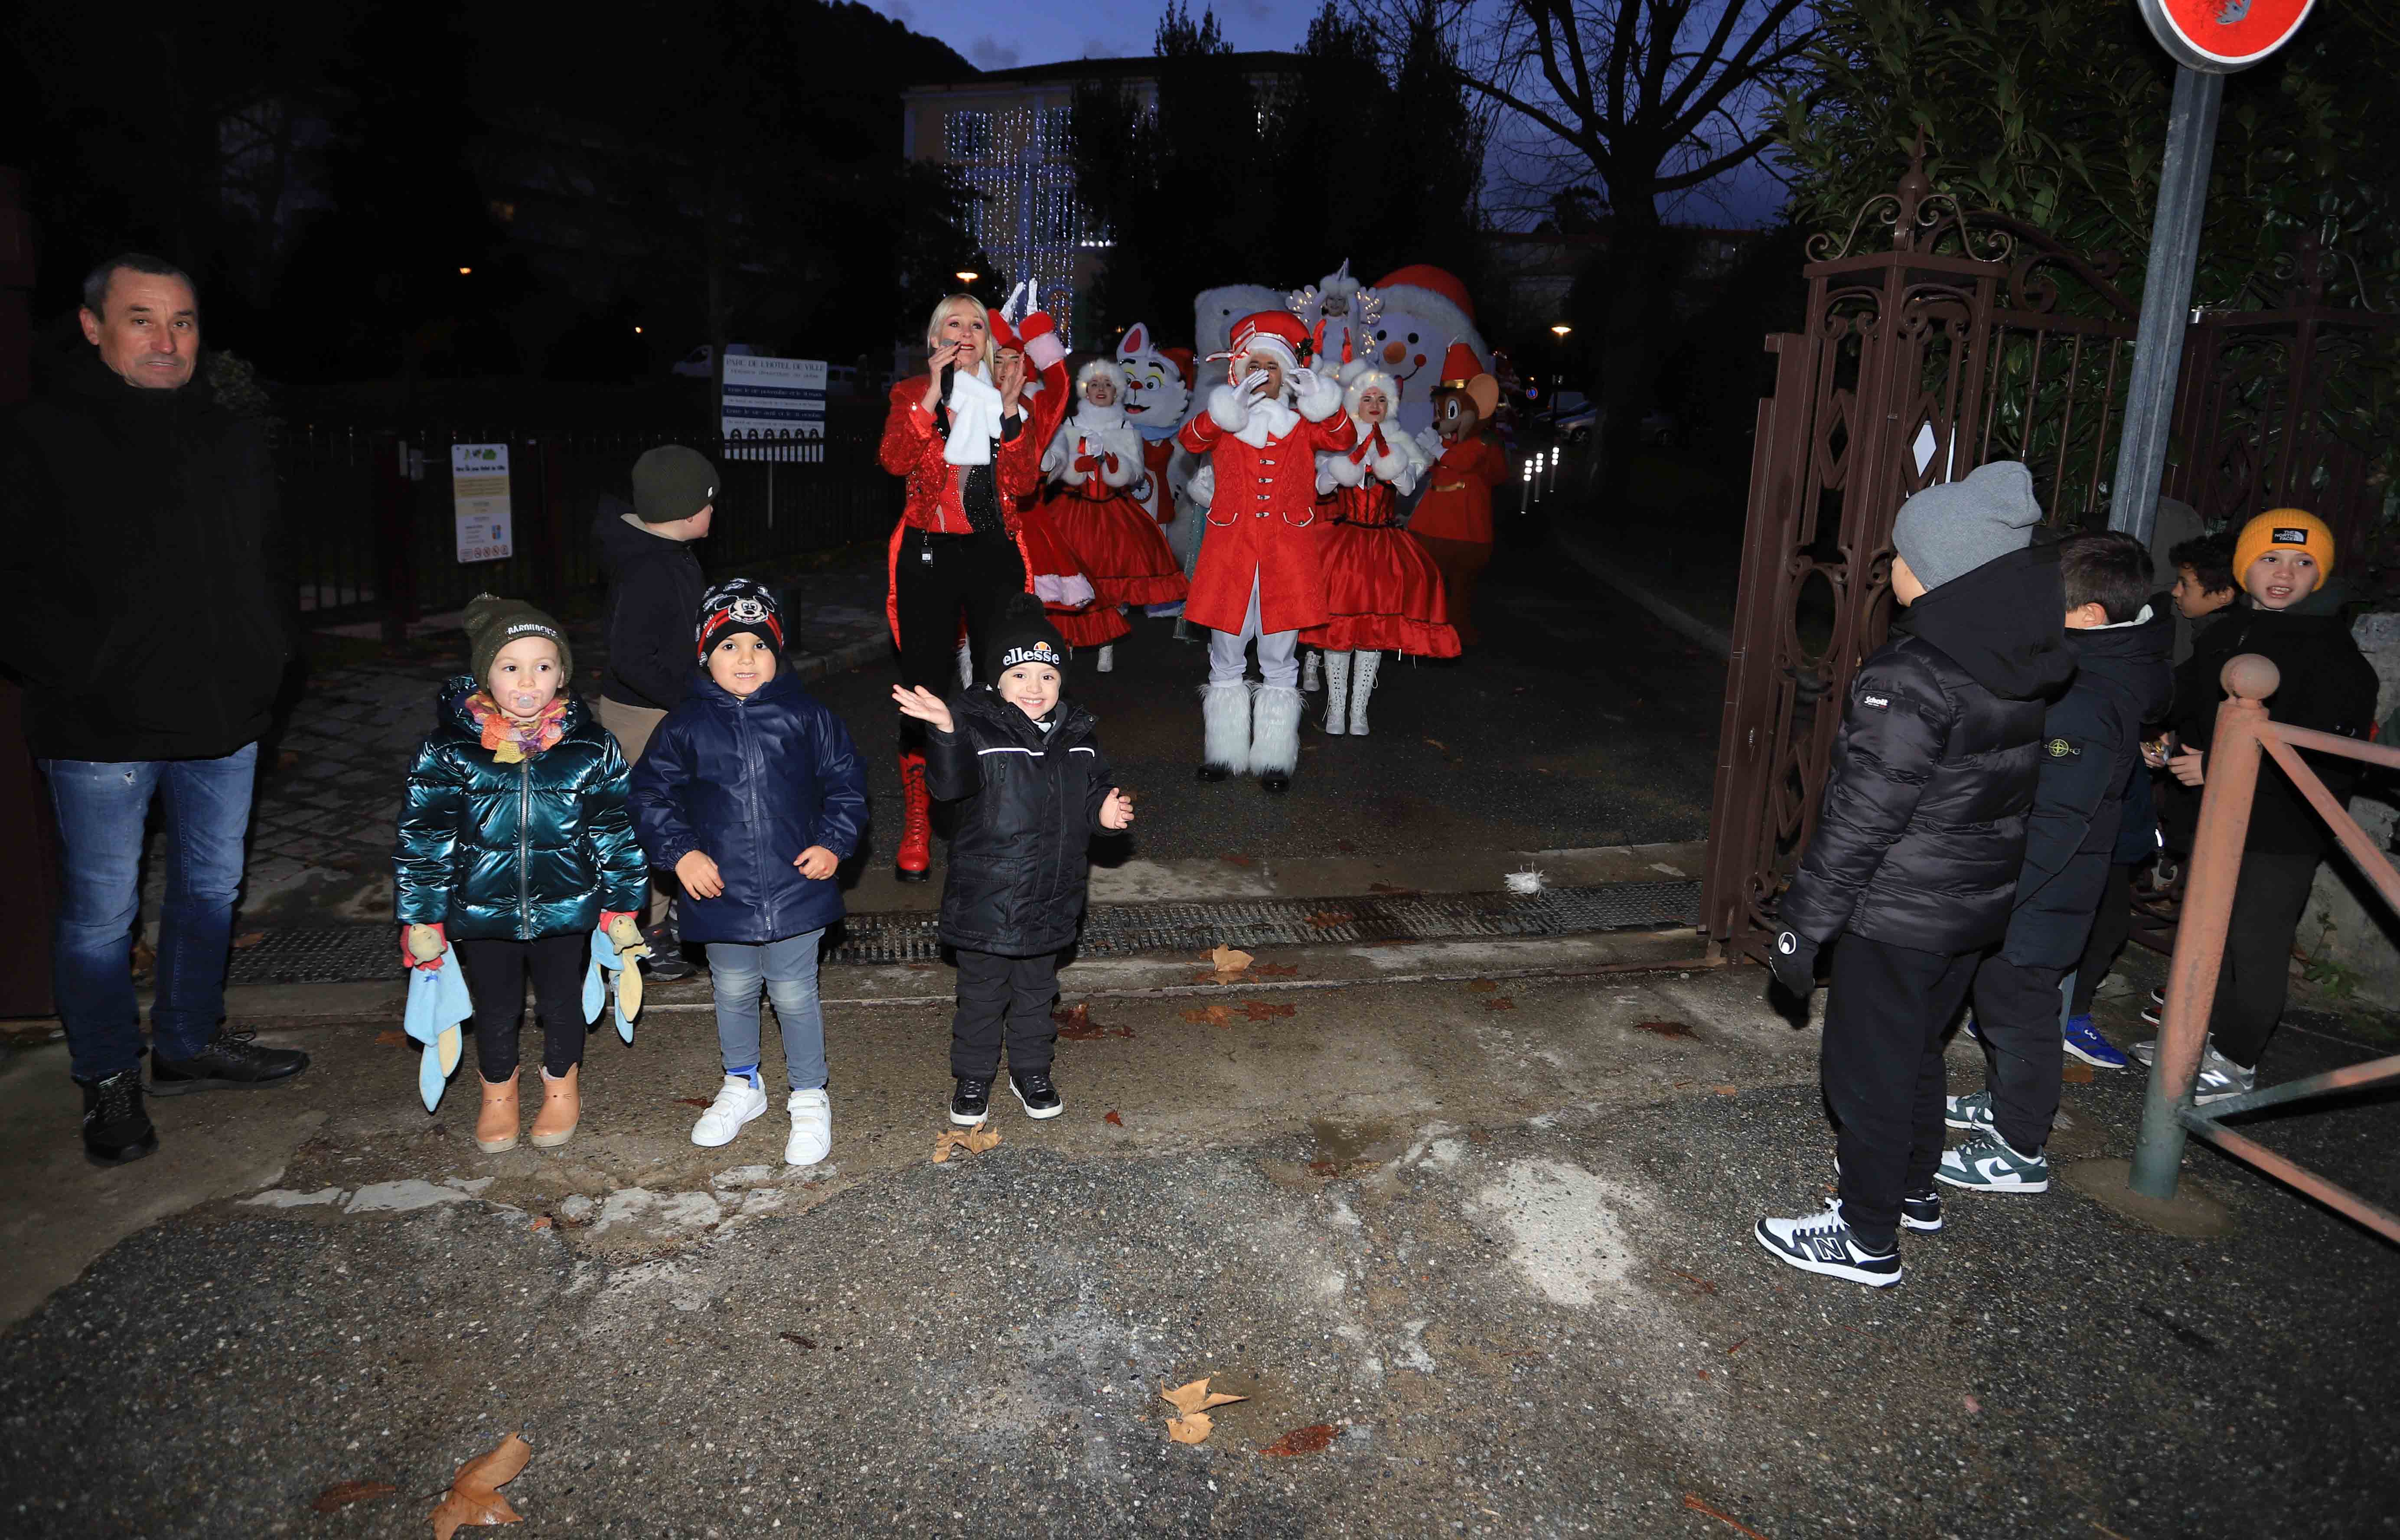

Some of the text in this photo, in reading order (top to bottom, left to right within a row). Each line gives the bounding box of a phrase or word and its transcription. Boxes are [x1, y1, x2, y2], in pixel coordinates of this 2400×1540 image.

[726, 357, 743, 366] PARC
[793, 362, 802, 370] DE
[805, 363, 823, 372] VILLE
[1003, 647, 1060, 666] ellesse
[1864, 696, 1888, 706] Schott
[1813, 1237, 1847, 1260] N
